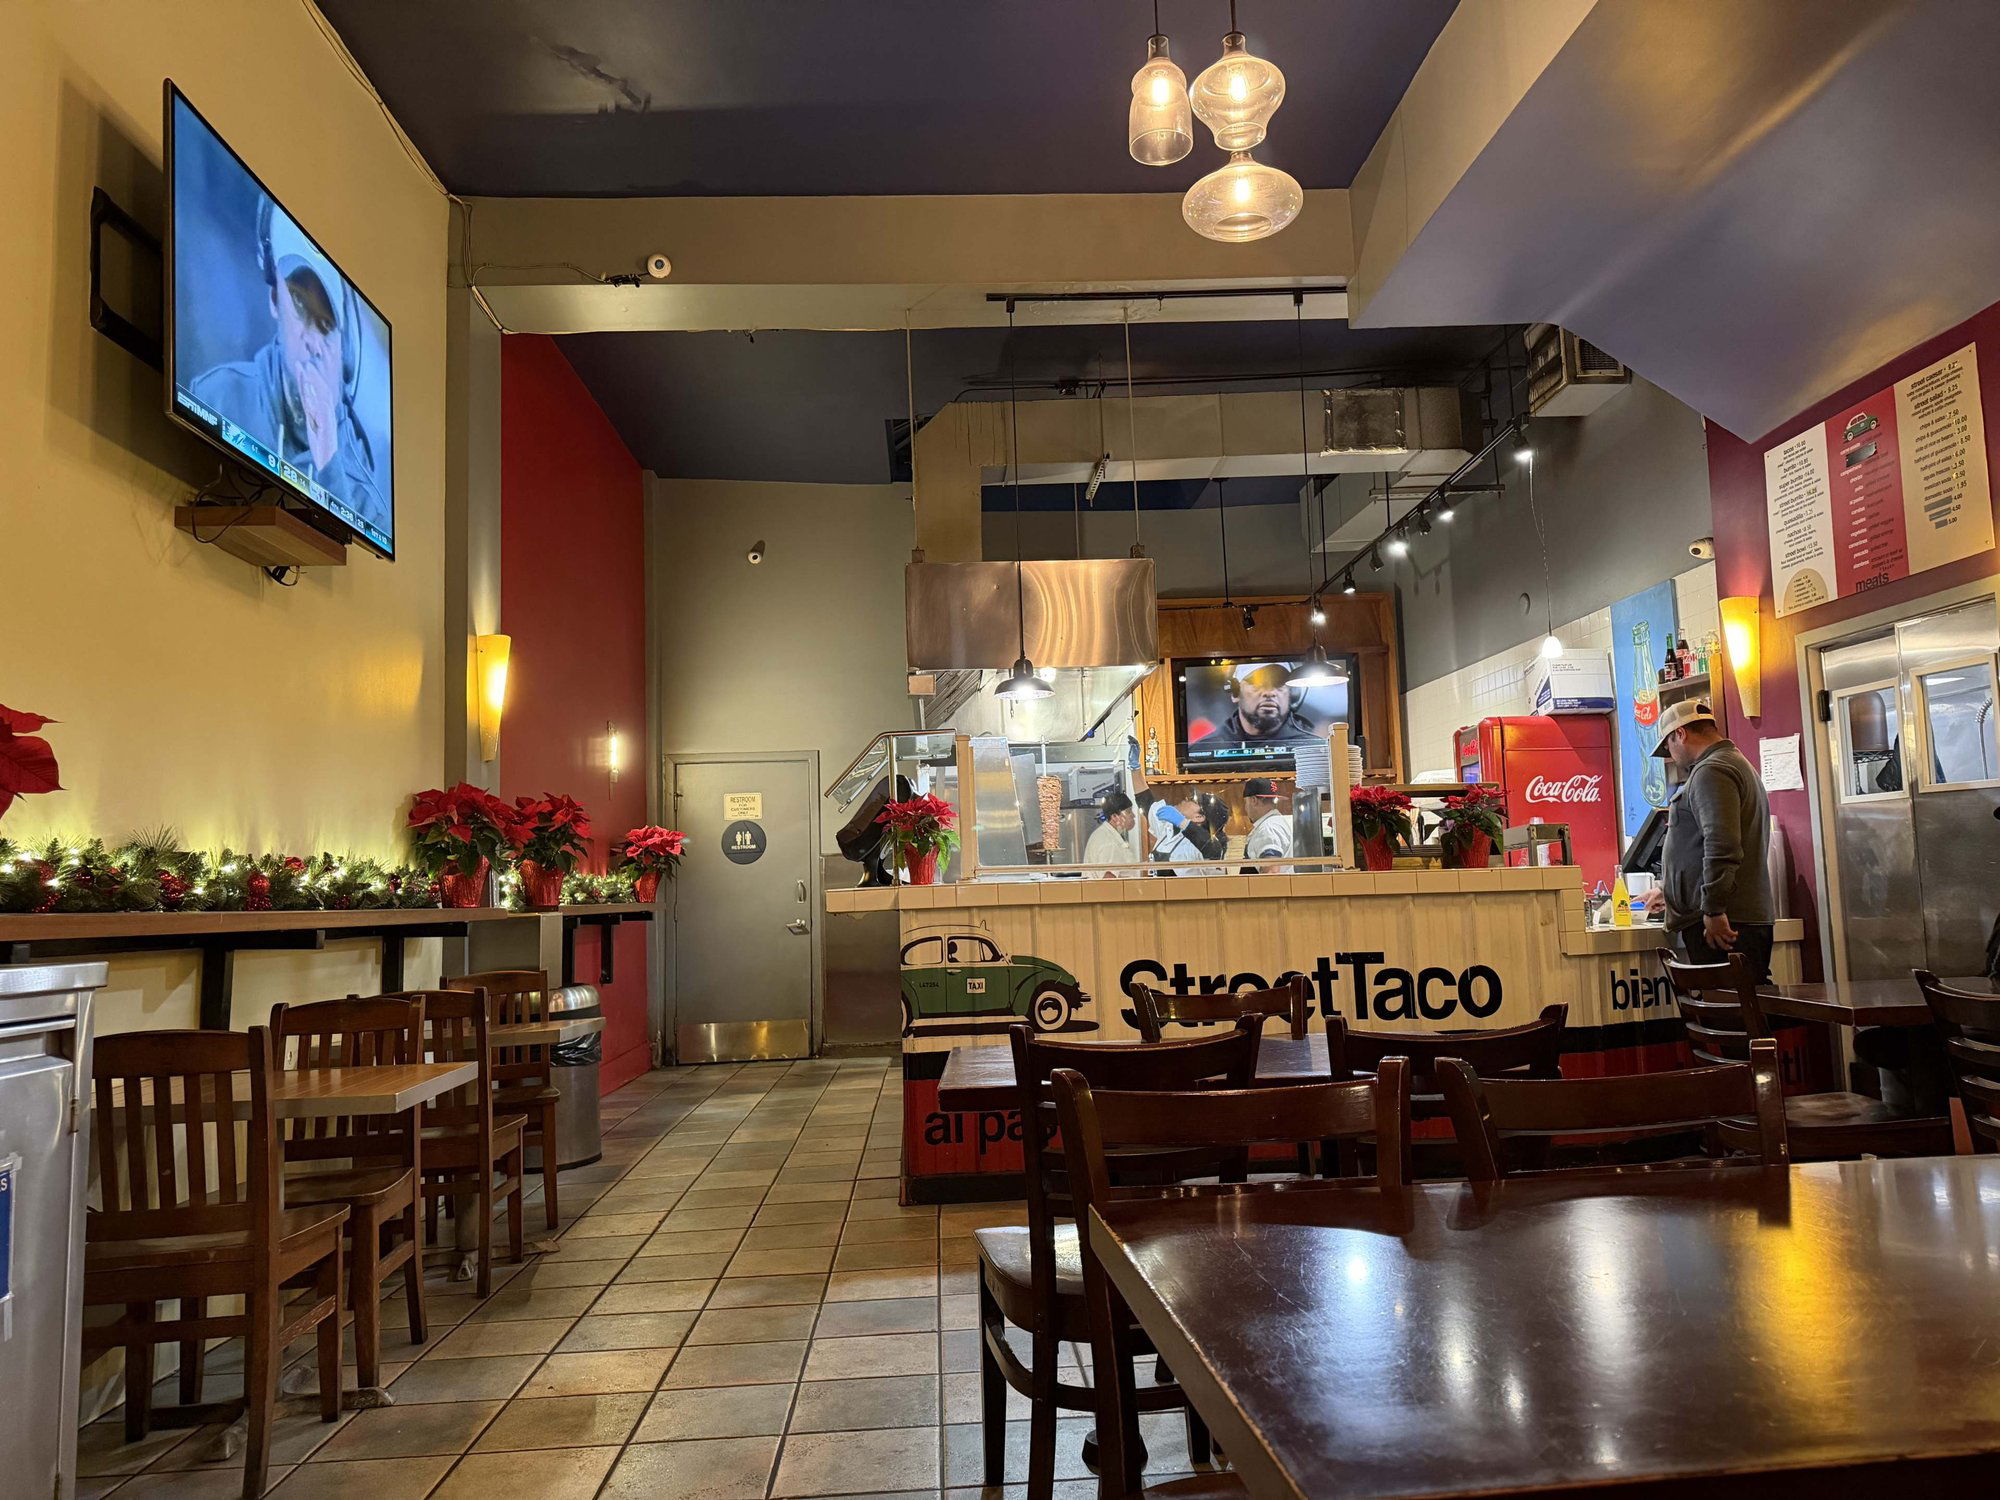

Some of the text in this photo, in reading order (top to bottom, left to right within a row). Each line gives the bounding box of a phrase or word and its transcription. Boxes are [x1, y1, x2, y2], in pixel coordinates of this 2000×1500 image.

[1856, 573, 1890, 594] meats
[1526, 774, 1603, 804] Coca-Cola
[968, 982, 984, 990] TAXI
